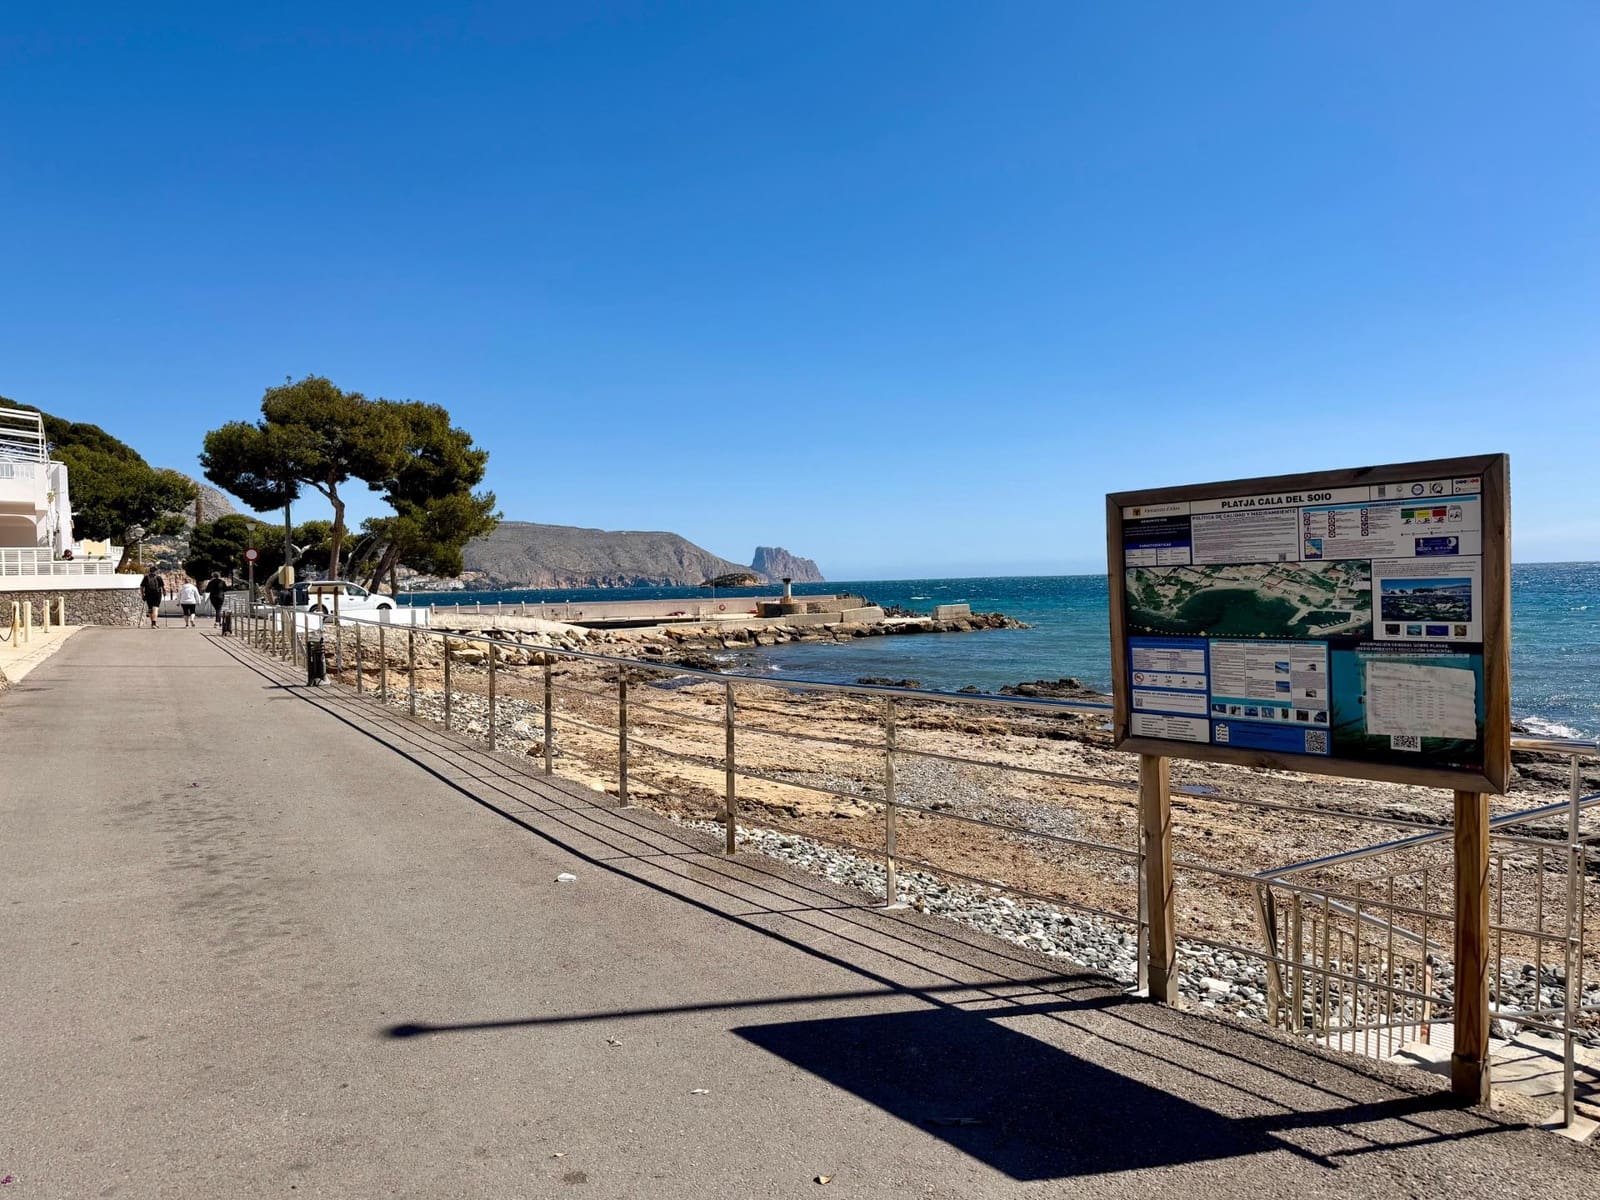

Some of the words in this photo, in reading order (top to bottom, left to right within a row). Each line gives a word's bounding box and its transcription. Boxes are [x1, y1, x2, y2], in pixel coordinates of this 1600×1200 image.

[1221, 499, 1256, 509] PLATJA
[1257, 497, 1283, 506] CALA
[1285, 495, 1305, 504] DEL
[1307, 492, 1332, 502] SOIO
